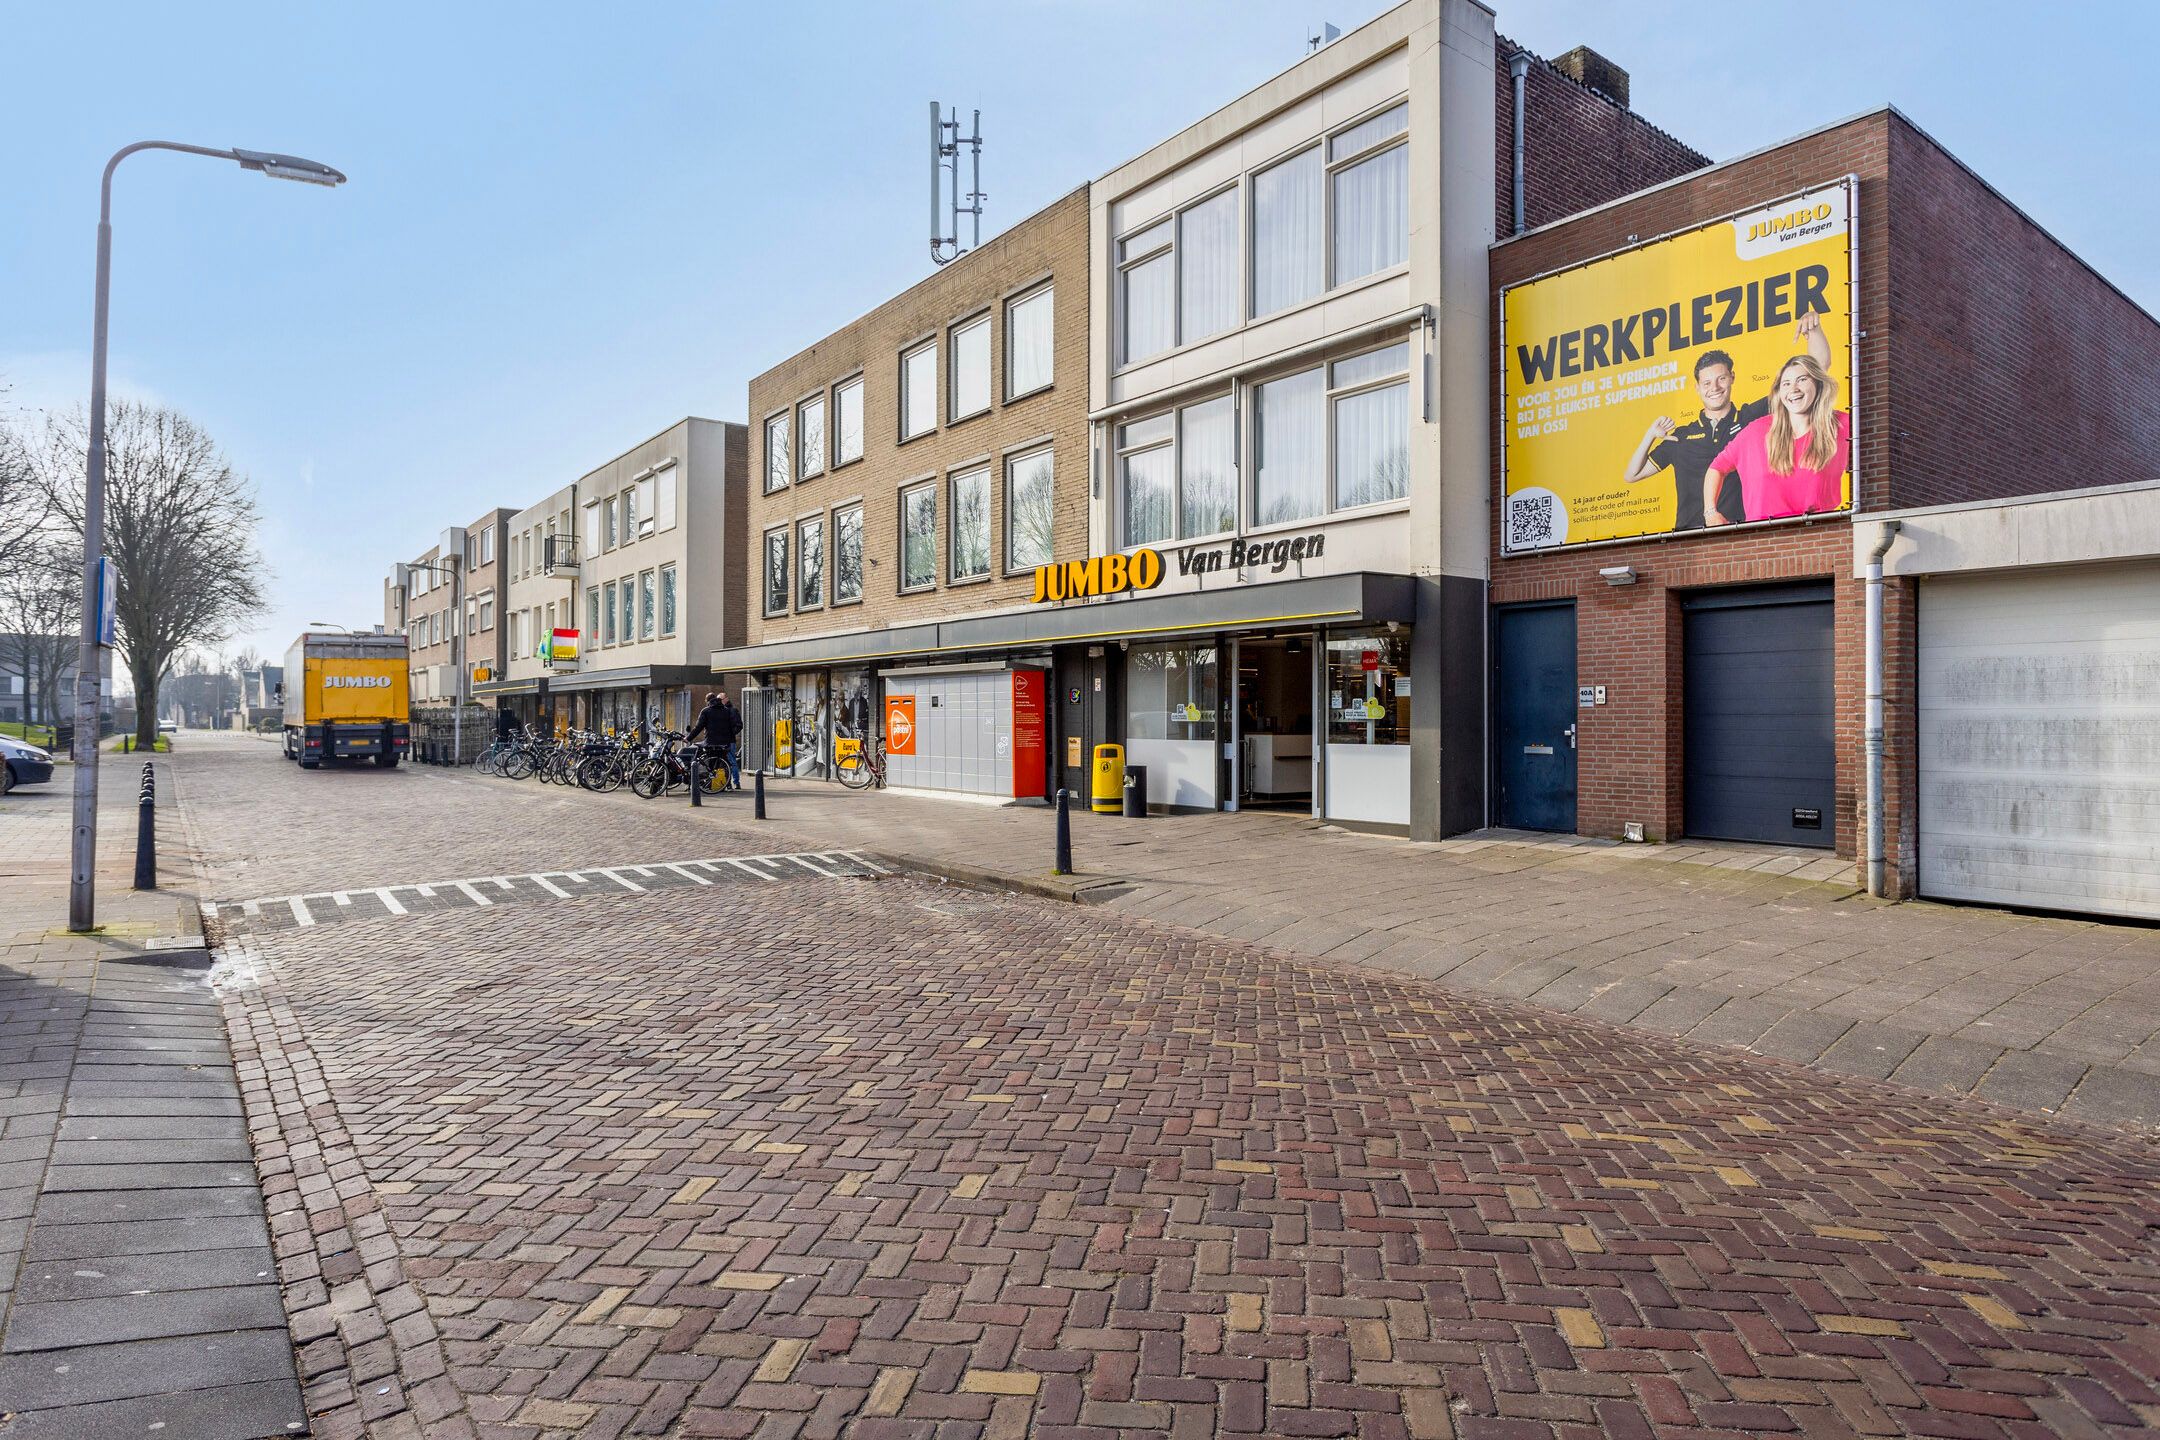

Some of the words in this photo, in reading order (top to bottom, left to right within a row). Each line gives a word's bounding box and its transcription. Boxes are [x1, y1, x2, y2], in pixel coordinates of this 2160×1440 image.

[1746, 203, 1832, 242] JUMBO
[1779, 232, 1797, 242] Van
[1799, 221, 1833, 235] Bergen
[1517, 264, 1831, 385] WERKPLEZIER
[1517, 393, 1551, 409] VOOR
[1553, 385, 1578, 401] JOU
[1581, 379, 1595, 394] ÉN
[1600, 377, 1613, 390] JE
[1617, 361, 1678, 386] VRIENDEN
[1517, 410, 1534, 425] BIJ
[1538, 406, 1552, 420] DE
[1555, 396, 1601, 416] LEUKSTE
[1605, 376, 1687, 406] SUPERMARKT
[1517, 424, 1540, 439] VAN
[1543, 419, 1568, 433] OSS!
[1573, 507, 1588, 515] Scan
[1589, 504, 1599, 512] de
[1600, 502, 1616, 510] code
[1626, 497, 1642, 507] mail
[1582, 496, 1596, 505] jaar
[1597, 493, 1605, 501] of
[1605, 490, 1630, 500] ouder?
[1573, 505, 1661, 523] sollicitatie@jumbo-oss.nl
[1030, 548, 1166, 604] JUMBO
[1178, 546, 1222, 577] Van
[1229, 532, 1326, 574] Bergen
[325, 675, 392, 688] JUMBO
